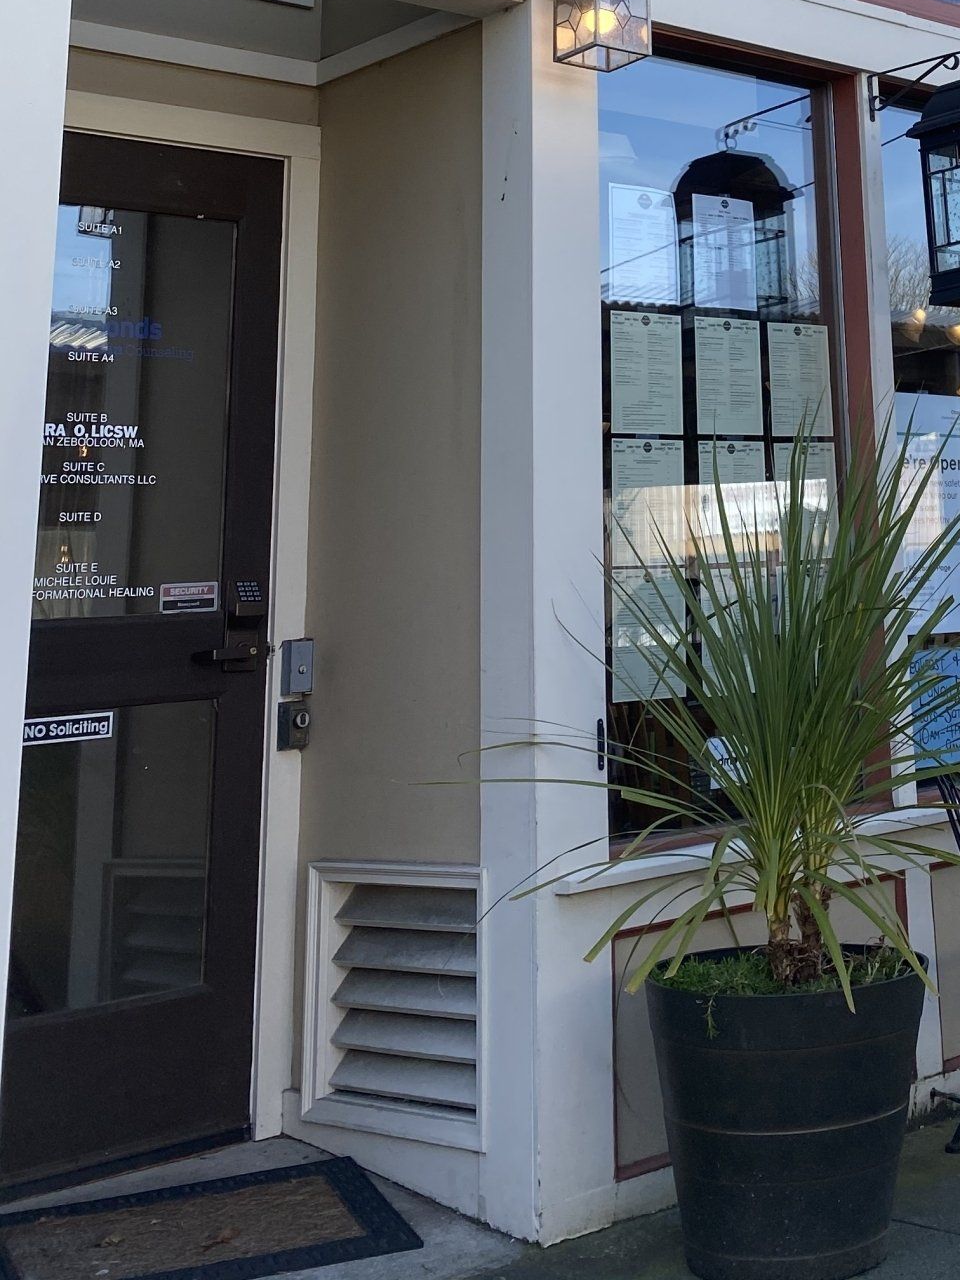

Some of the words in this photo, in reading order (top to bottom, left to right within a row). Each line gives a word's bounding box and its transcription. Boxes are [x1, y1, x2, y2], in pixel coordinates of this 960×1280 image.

[78, 221, 108, 234] SUITE
[110, 225, 122, 235] A1
[107, 260, 121, 269] A2
[105, 306, 118, 316] A3
[68, 351, 99, 362] SUITE
[101, 352, 114, 363] A4
[66, 412, 98, 423] SUITE
[100, 413, 108, 423] B
[91, 424, 139, 439] LICSW
[129, 438, 145, 448] MA
[62, 462, 95, 472] SUITE
[97, 462, 105, 472] C
[60, 474, 135, 485] CONSULTANTS
[137, 475, 157, 485] LLC
[59, 512, 92, 522] SUITE
[94, 512, 102, 522] D
[55, 563, 88, 573] SUITE
[91, 563, 99, 572] E
[33, 577, 83, 587] MICHELE
[85, 575, 118, 586] LOUIE
[109, 586, 155, 598] HEALING
[169, 586, 208, 596] SECURITY
[23, 724, 46, 739] NO
[48, 720, 109, 736] Soliciting
